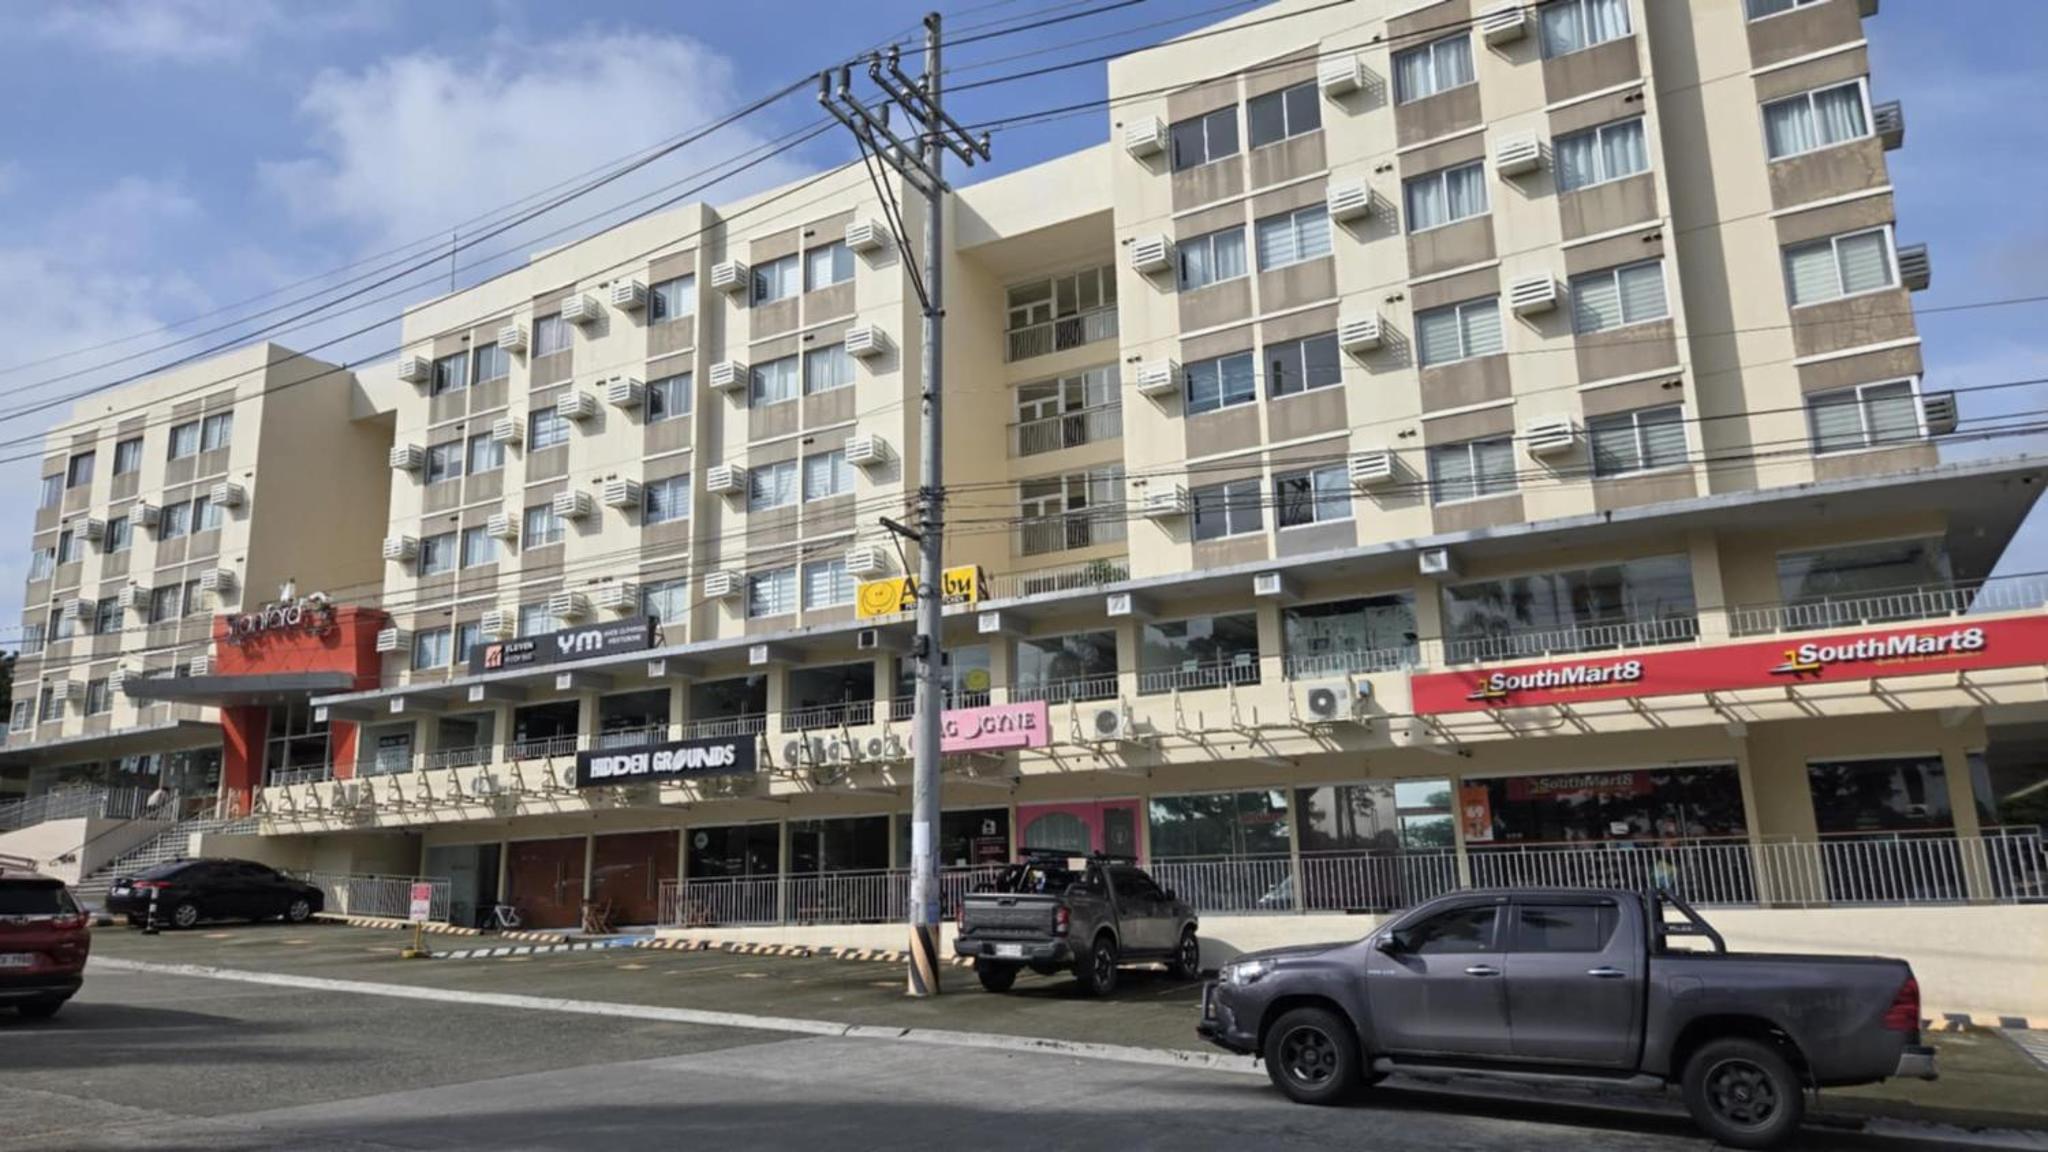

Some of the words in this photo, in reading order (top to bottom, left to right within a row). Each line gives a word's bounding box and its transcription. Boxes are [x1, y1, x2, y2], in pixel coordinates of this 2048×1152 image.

[900, 573, 971, 602] Abu
[1798, 628, 1984, 663] SouthMart8
[1490, 660, 1640, 690] SouthMart8
[590, 753, 649, 778] HIDDEN
[1540, 773, 1634, 790] SouthMart8
